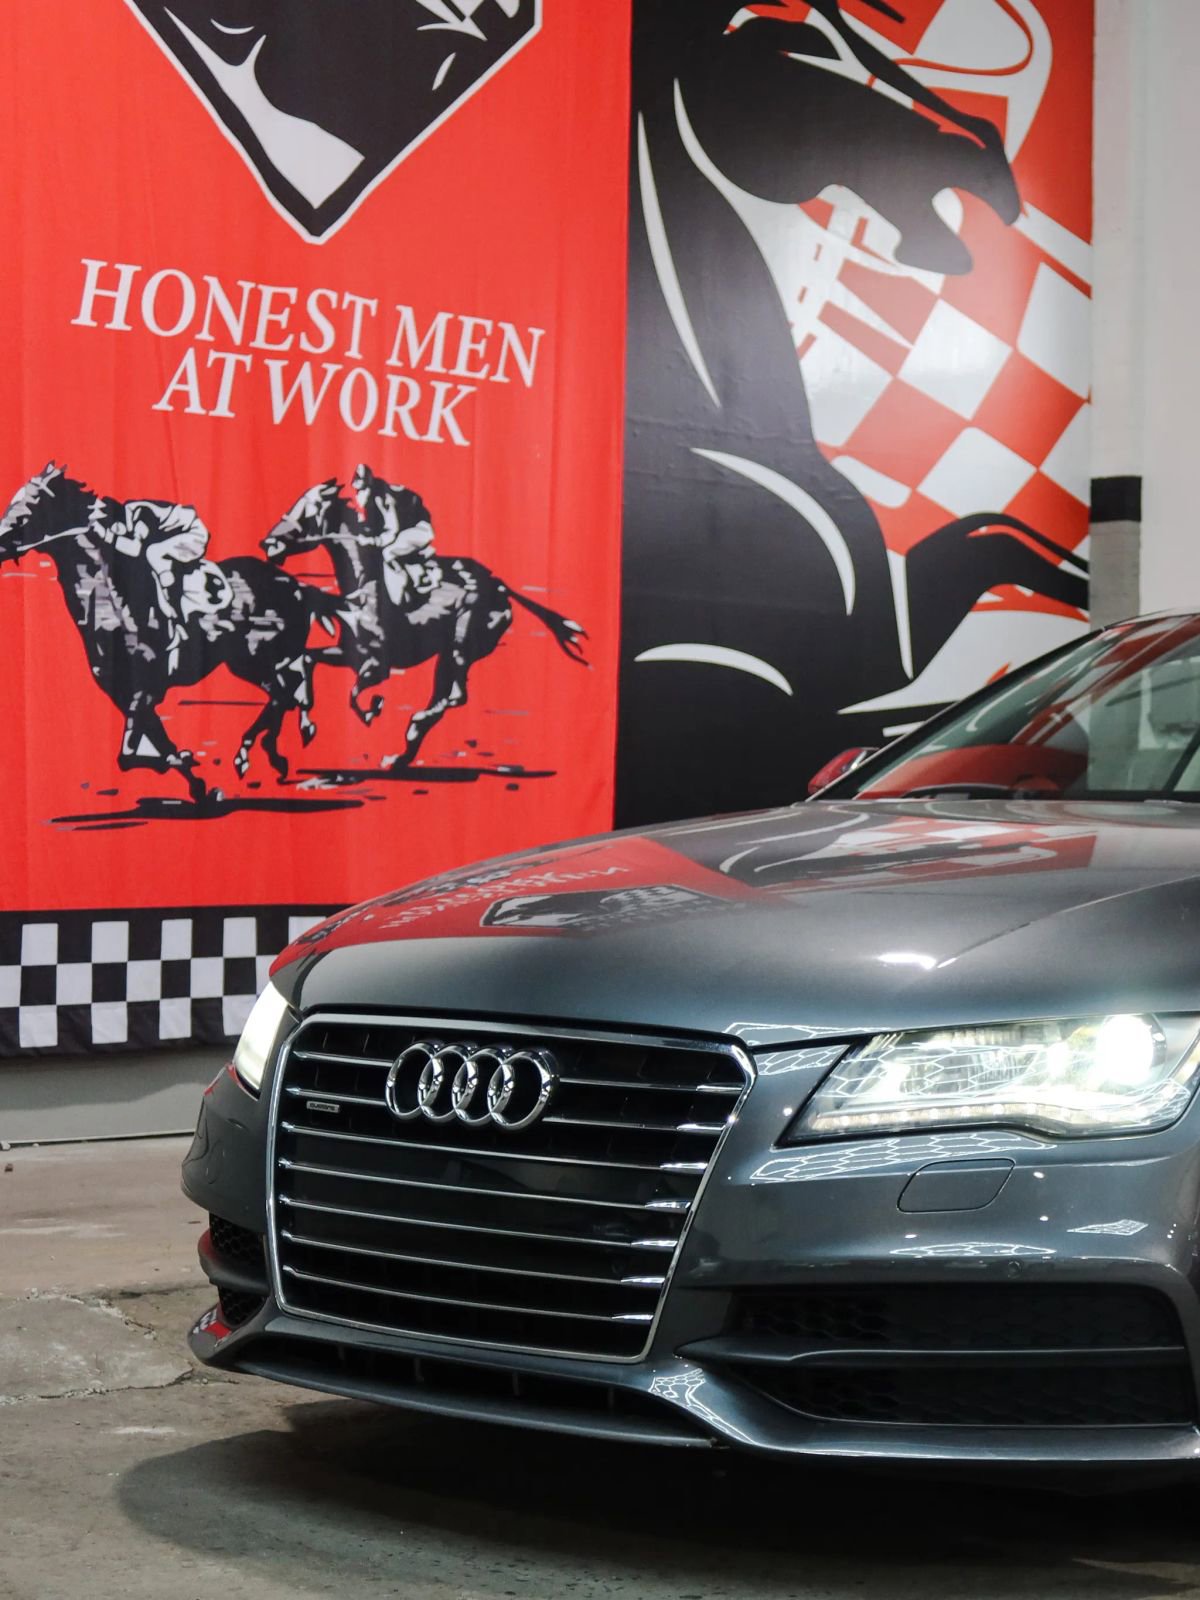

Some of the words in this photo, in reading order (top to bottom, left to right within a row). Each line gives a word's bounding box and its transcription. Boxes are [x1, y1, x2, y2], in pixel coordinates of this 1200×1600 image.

[70, 258, 378, 360] HONEST
[385, 304, 545, 388] MEN
[151, 347, 253, 418] AT
[264, 358, 477, 447] WORK
